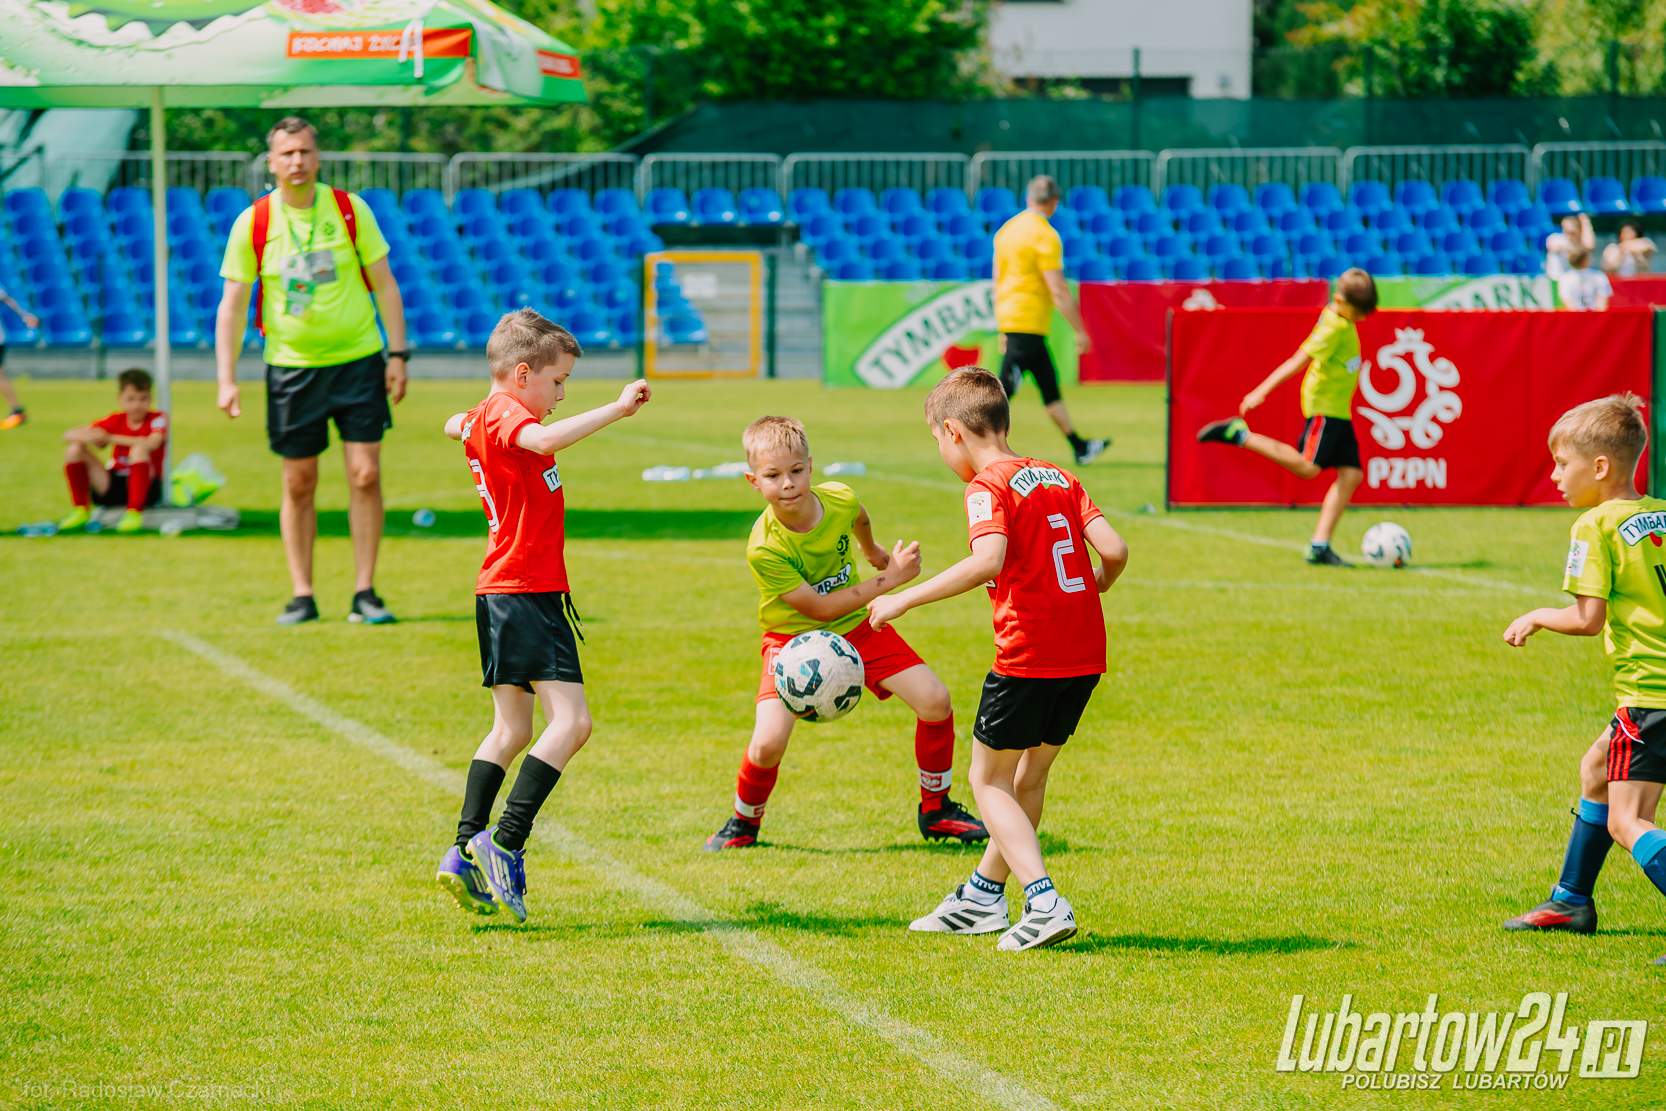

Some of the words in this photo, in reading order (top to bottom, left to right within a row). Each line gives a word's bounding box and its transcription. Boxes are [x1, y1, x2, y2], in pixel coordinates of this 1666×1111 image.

[1367, 456, 1447, 489] PZPN
[1623, 514, 1666, 538] TYMBA
[1047, 513, 1086, 593] 2
